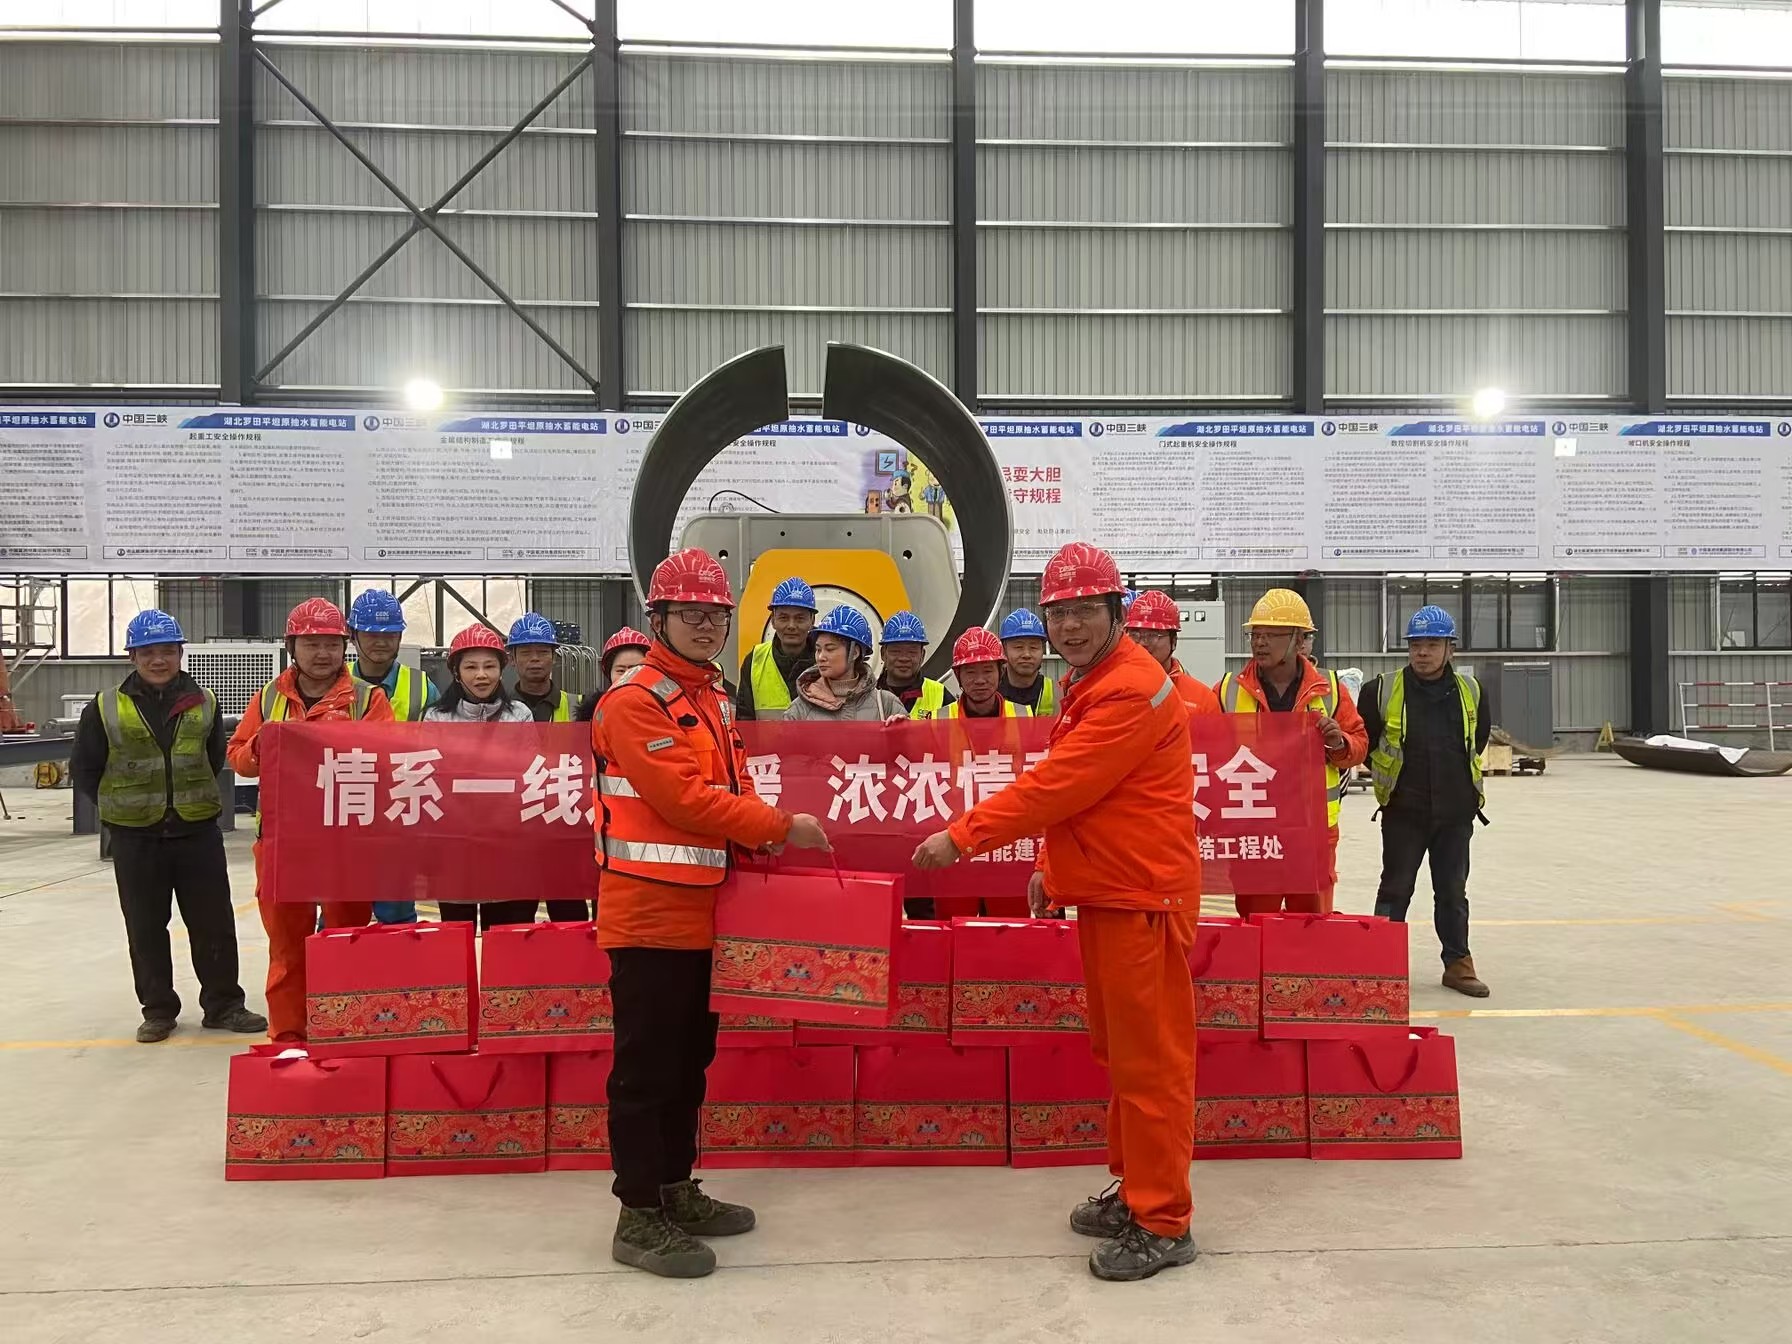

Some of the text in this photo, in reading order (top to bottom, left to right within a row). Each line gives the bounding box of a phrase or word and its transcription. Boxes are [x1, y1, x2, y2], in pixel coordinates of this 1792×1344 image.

[0, 415, 87, 425] 平坦原抽水蓄能电站
[122, 413, 168, 424] 中国三峡
[1106, 422, 1147, 433] 中国三峡
[1338, 422, 1379, 432] 中国三峡
[1428, 424, 1538, 433] 湖北罗田平水蓄能电站
[1569, 422, 1609, 432] 中国三峡
[728, 439, 777, 448] 安全操作规程
[1009, 488, 1061, 504] 守规程
